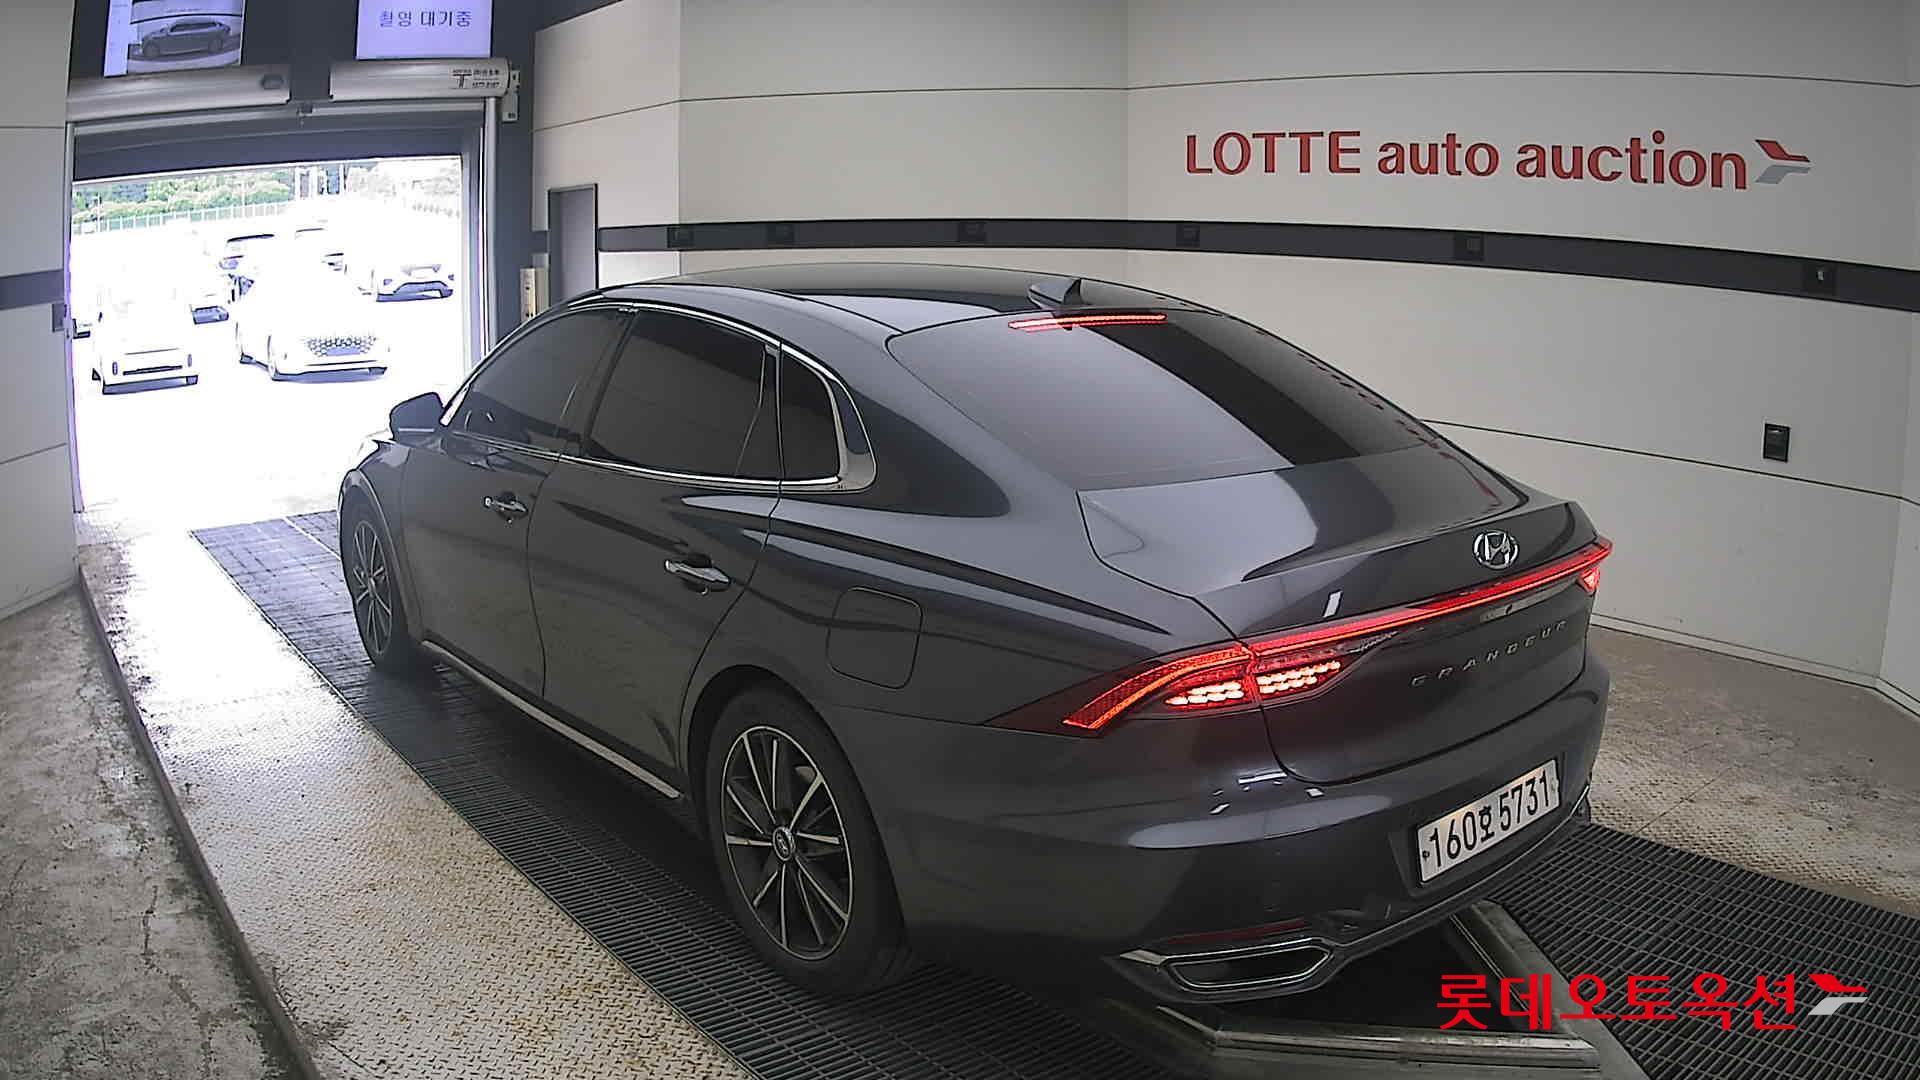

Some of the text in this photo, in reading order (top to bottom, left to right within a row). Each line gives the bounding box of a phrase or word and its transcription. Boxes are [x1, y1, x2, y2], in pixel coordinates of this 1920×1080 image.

[420, 10, 472, 28] 대기중
[1186, 130, 1748, 190] LOTTE auto auction
[1411, 619, 1568, 687] GRANDEUR
